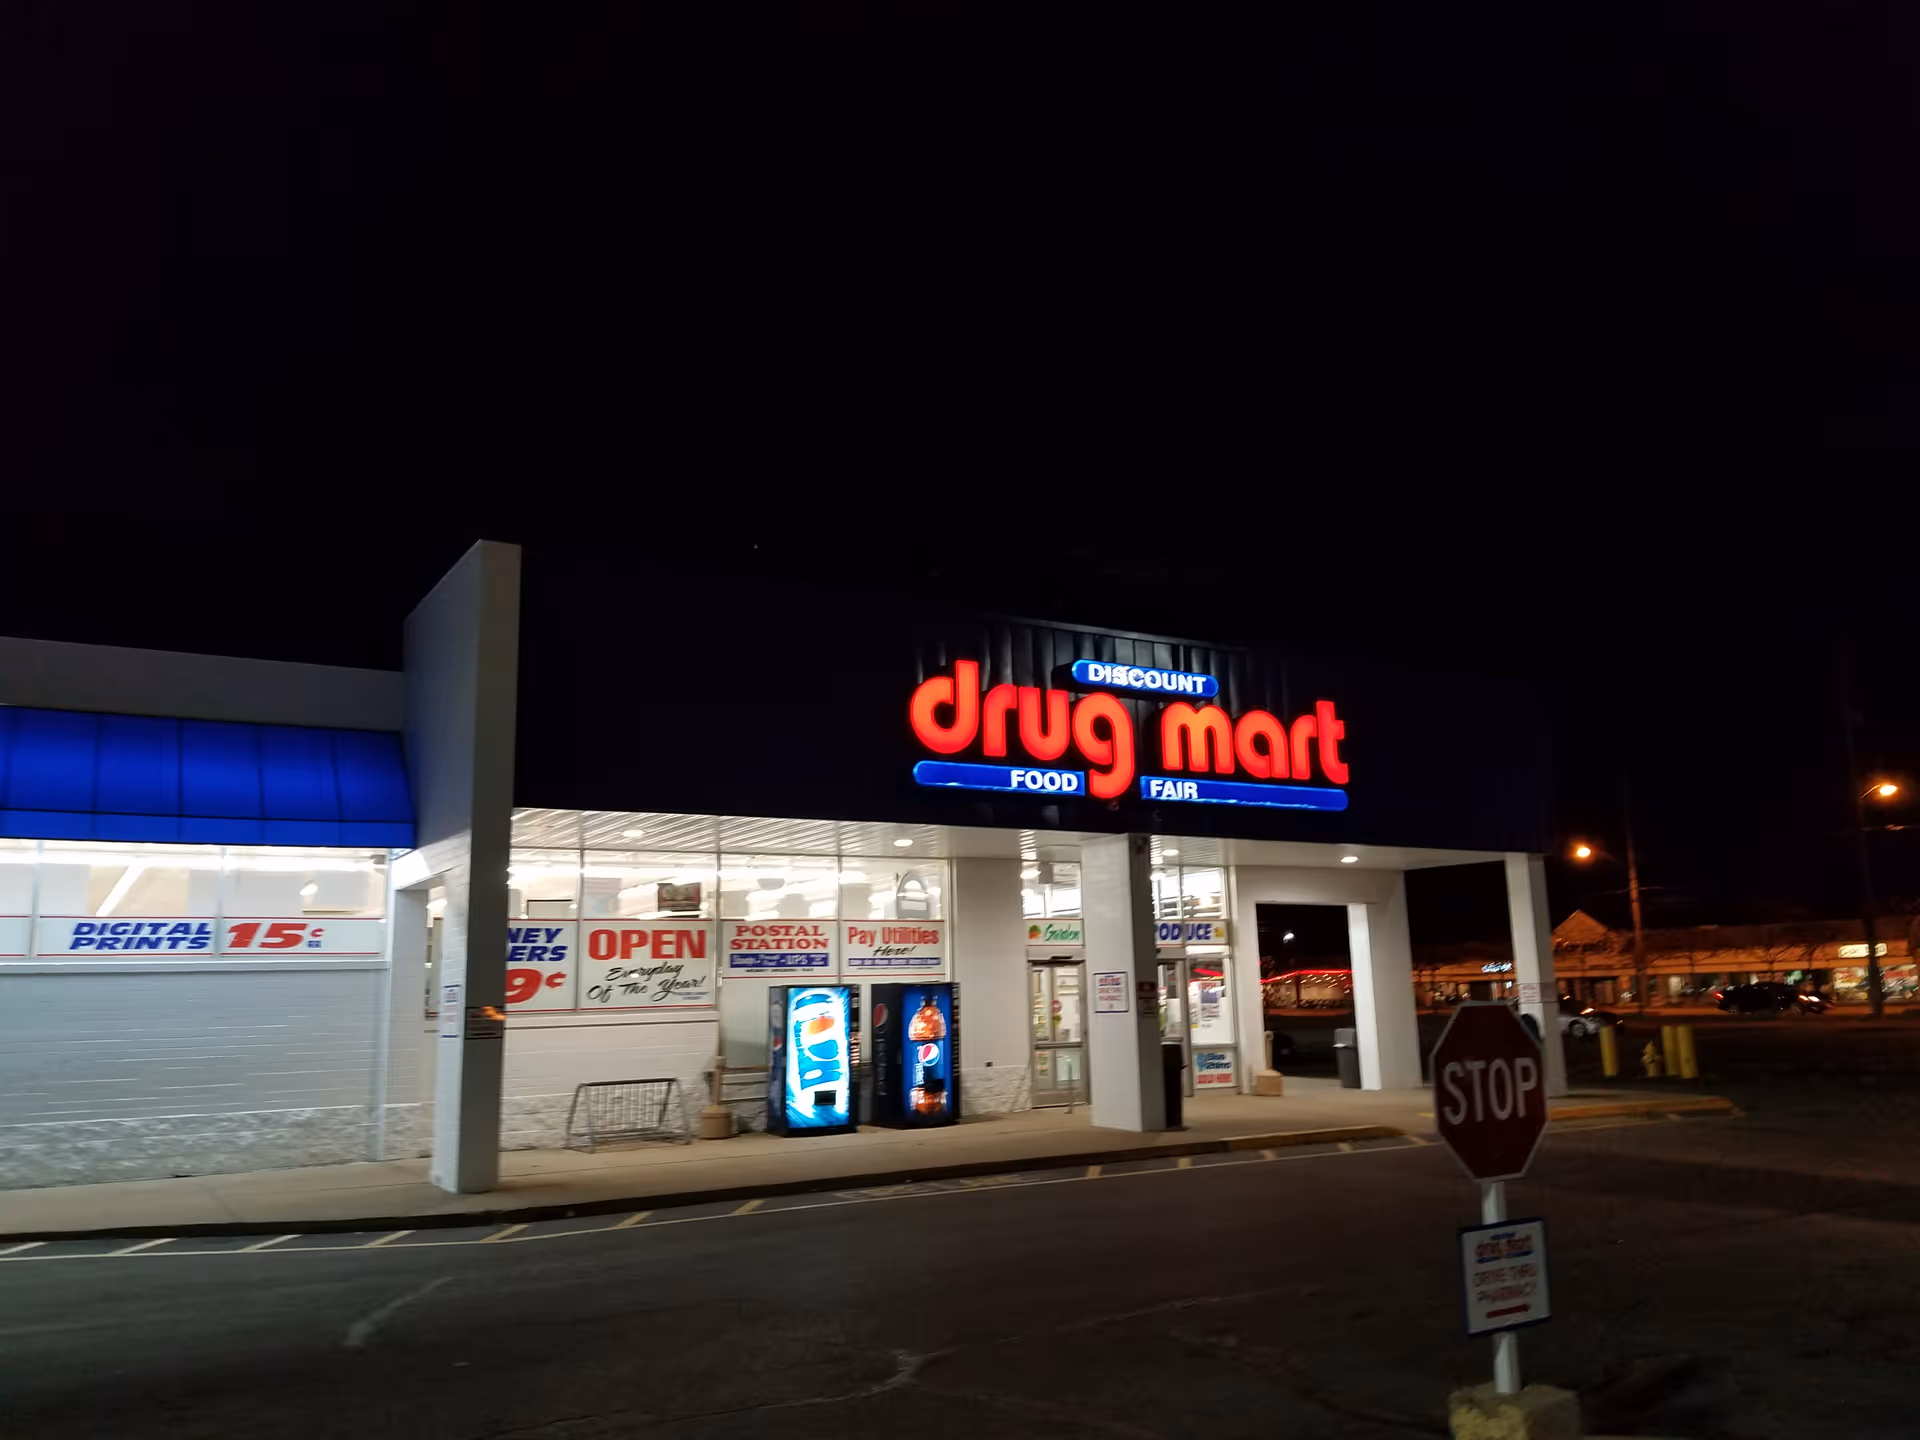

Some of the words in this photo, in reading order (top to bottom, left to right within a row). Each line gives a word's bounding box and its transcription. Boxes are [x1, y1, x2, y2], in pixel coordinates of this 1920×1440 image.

[1088, 662, 1207, 693] DISCOUNT
[911, 660, 1135, 798] drug
[1161, 701, 1349, 785] mart
[1010, 769, 1079, 792] FOOD
[1149, 779, 1199, 800] FAIR
[73, 922, 213, 935] DIGITAL
[508, 927, 564, 943] NEY
[735, 925, 825, 937] POSTAL
[848, 926, 877, 947] Pay
[882, 927, 940, 944] Utilities
[1155, 923, 1212, 940] ODUCE
[68, 936, 213, 950] PRINTS
[588, 929, 706, 960] OPEN
[729, 938, 830, 950] STATION
[872, 945, 917, 956] Here!
[505, 945, 568, 961] ERS
[605, 961, 685, 982] Everyday
[587, 984, 614, 1003] Of
[619, 982, 648, 996] The
[652, 975, 706, 1002] Year!
[1442, 1057, 1538, 1125] STOP
